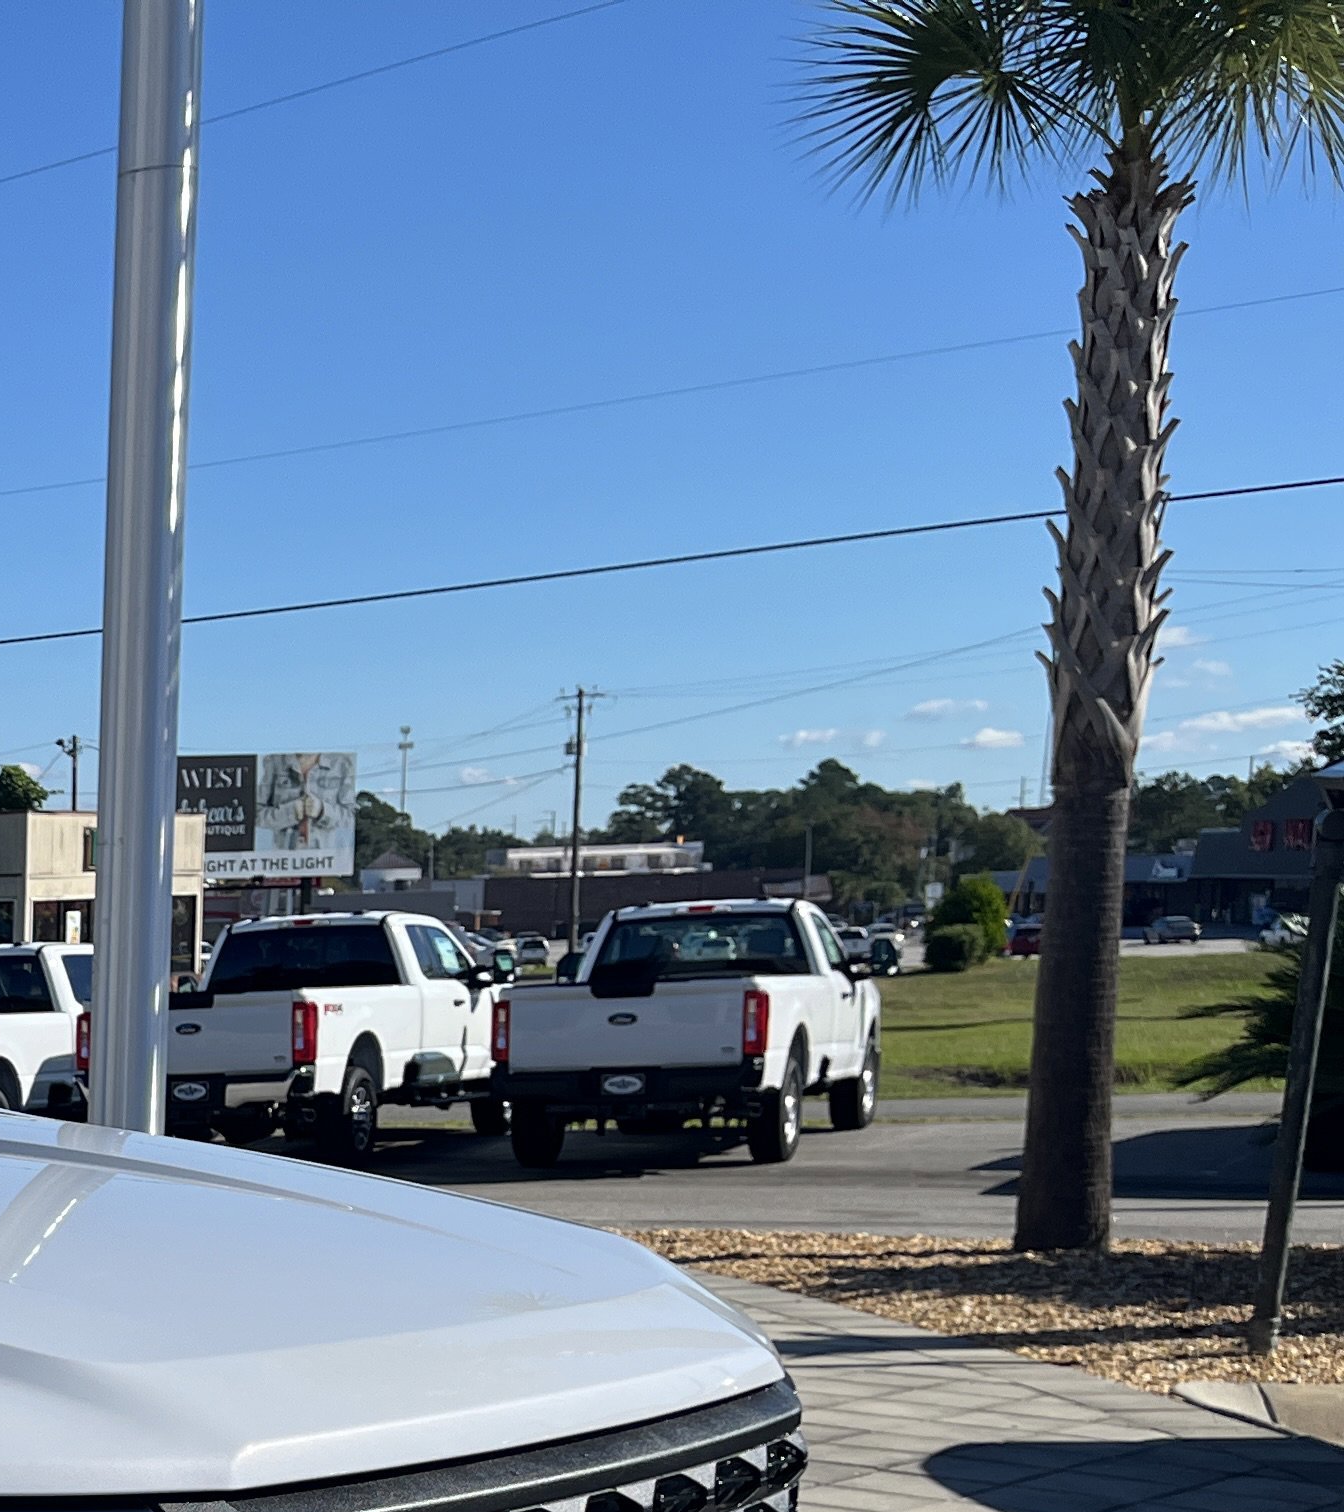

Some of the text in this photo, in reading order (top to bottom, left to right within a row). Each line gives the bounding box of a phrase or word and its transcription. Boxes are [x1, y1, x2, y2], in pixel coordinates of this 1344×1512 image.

[181, 767, 248, 788] WEST
[240, 859, 257, 871] AT
[262, 858, 289, 870] THE
[292, 856, 334, 870] LIGHT
